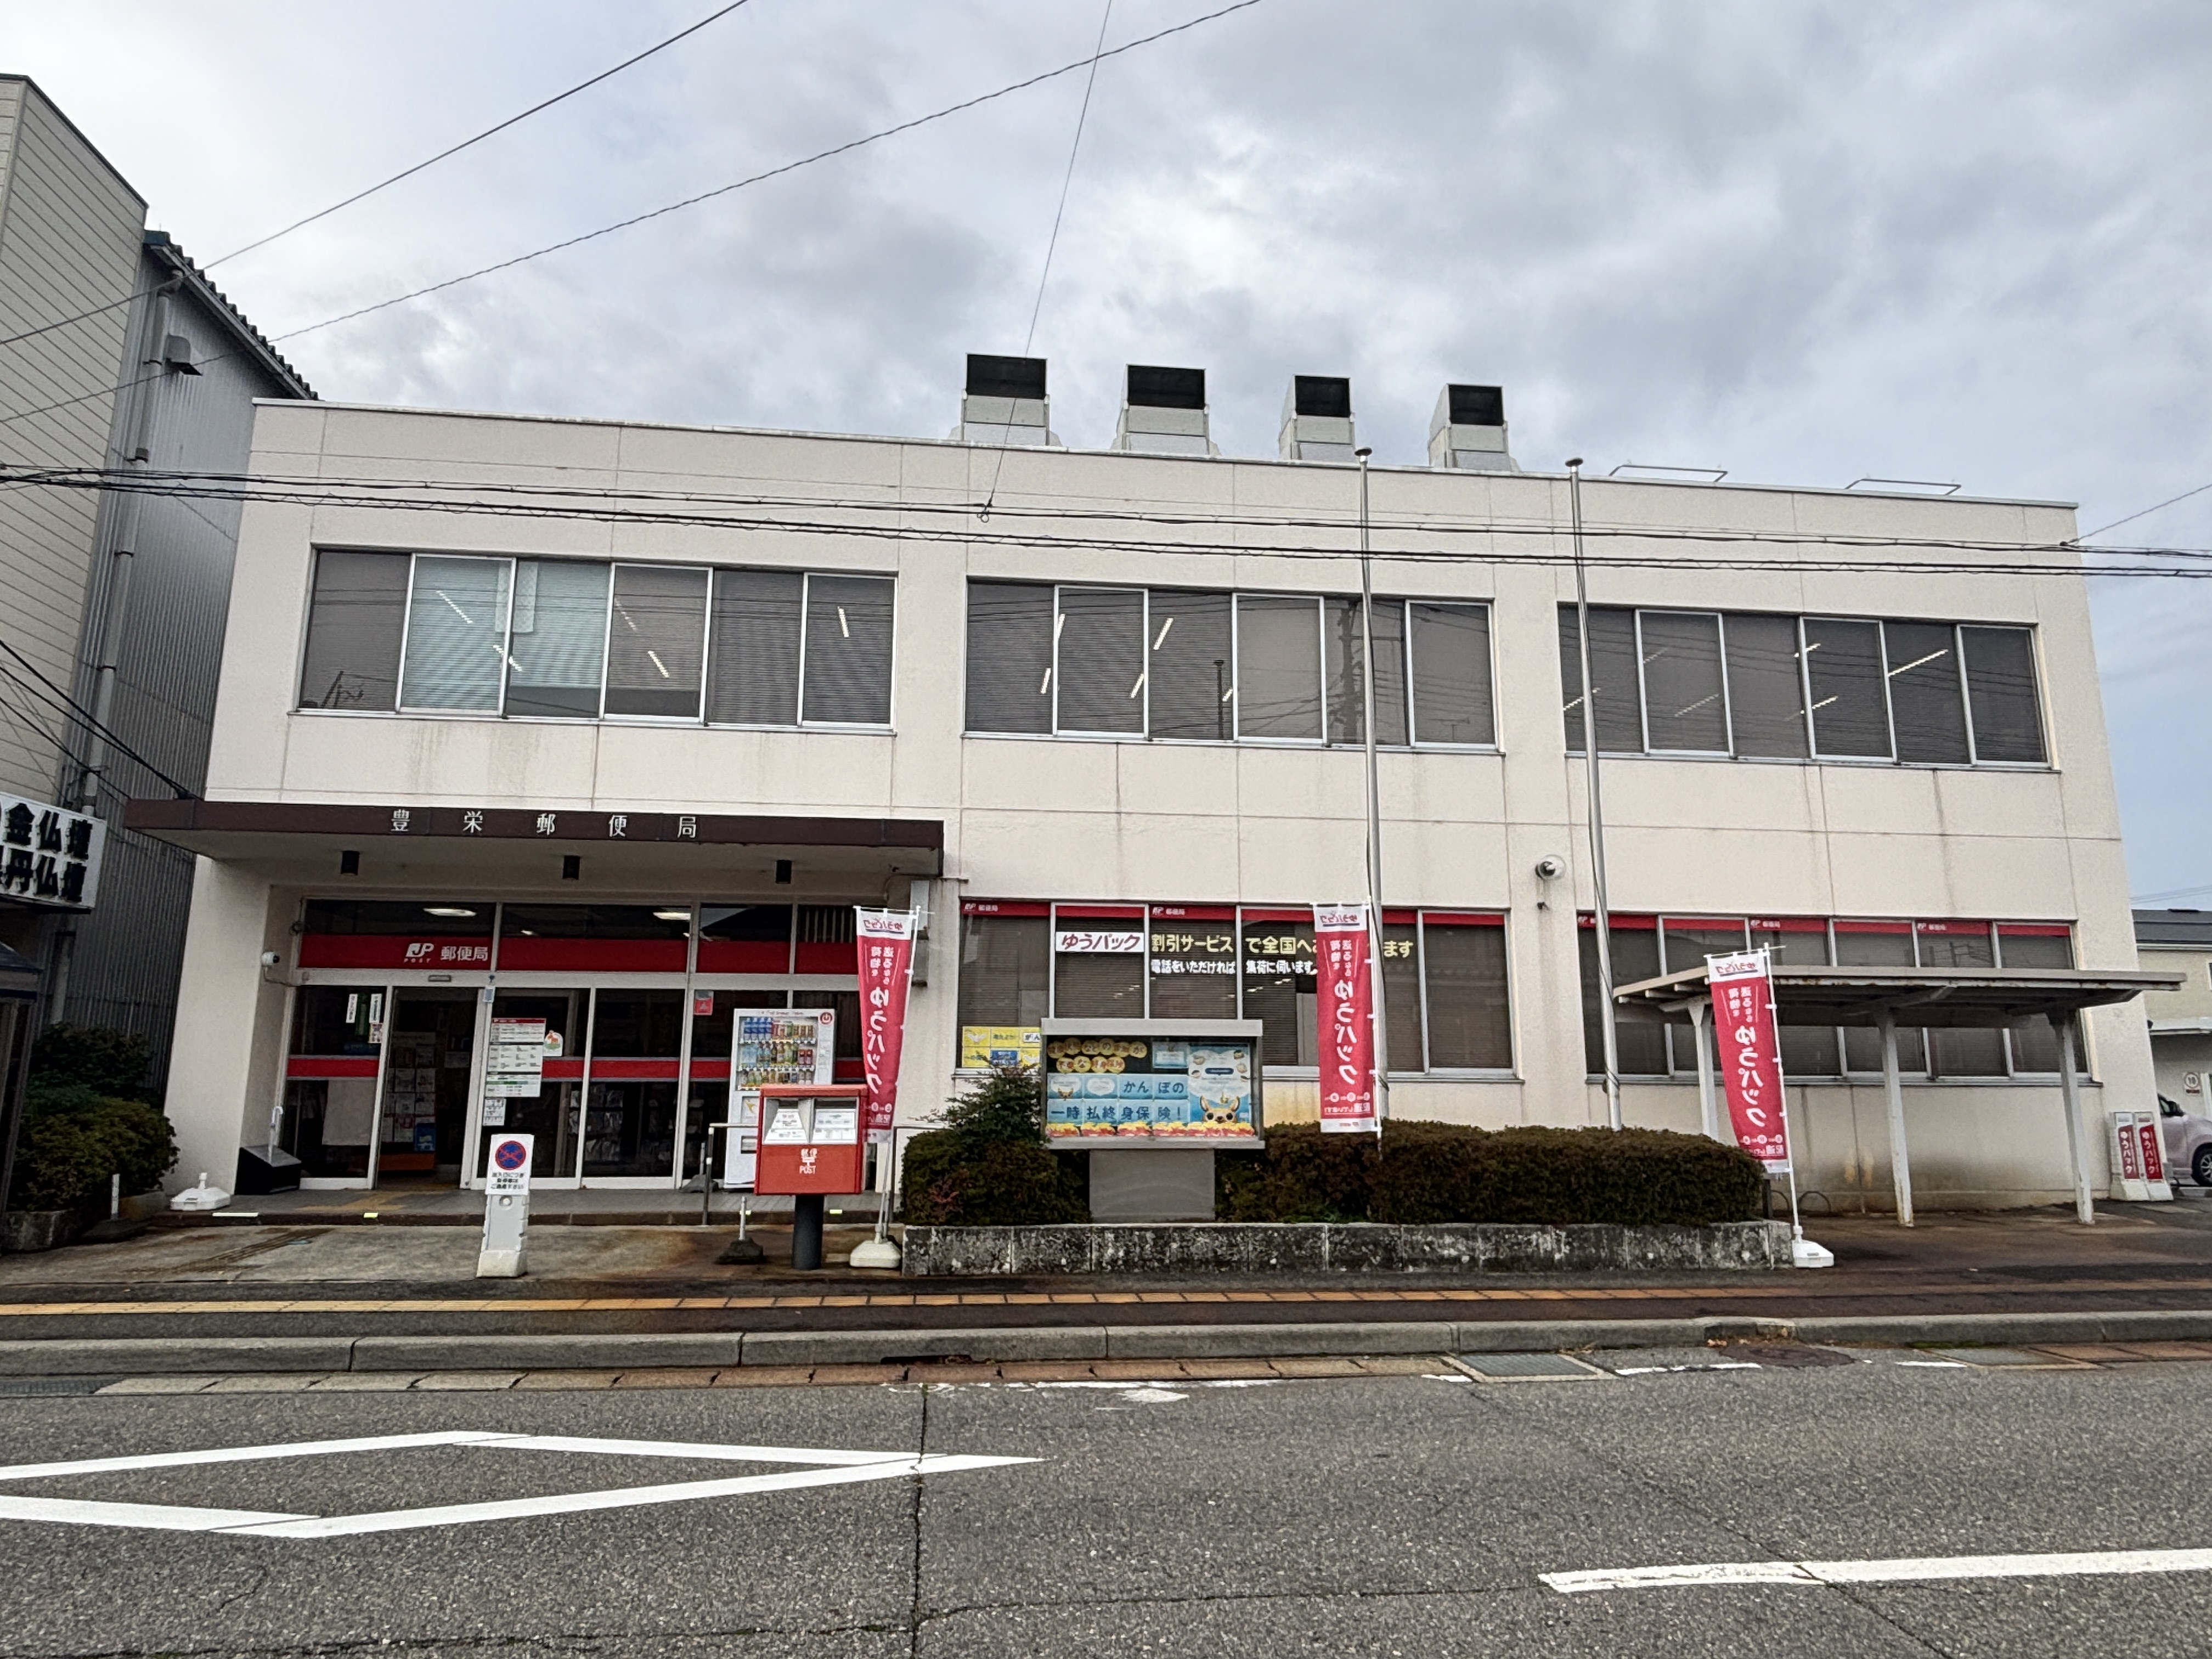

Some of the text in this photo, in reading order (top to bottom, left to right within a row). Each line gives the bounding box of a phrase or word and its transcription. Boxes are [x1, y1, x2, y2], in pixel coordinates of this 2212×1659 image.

[391, 809, 697, 838] 豊栄郵便局
[0, 803, 92, 860] 金仏壇
[1062, 933, 1141, 951] ゆうパック
[1152, 934, 1233, 952] 割引サービス
[1383, 940, 1414, 958] ます
[441, 946, 488, 961] 郵便局
[1151, 959, 1235, 974] 電話をいただければ
[1051, 1106, 1181, 1120] 一時払終身保険！
[799, 1165, 816, 1174] POST
